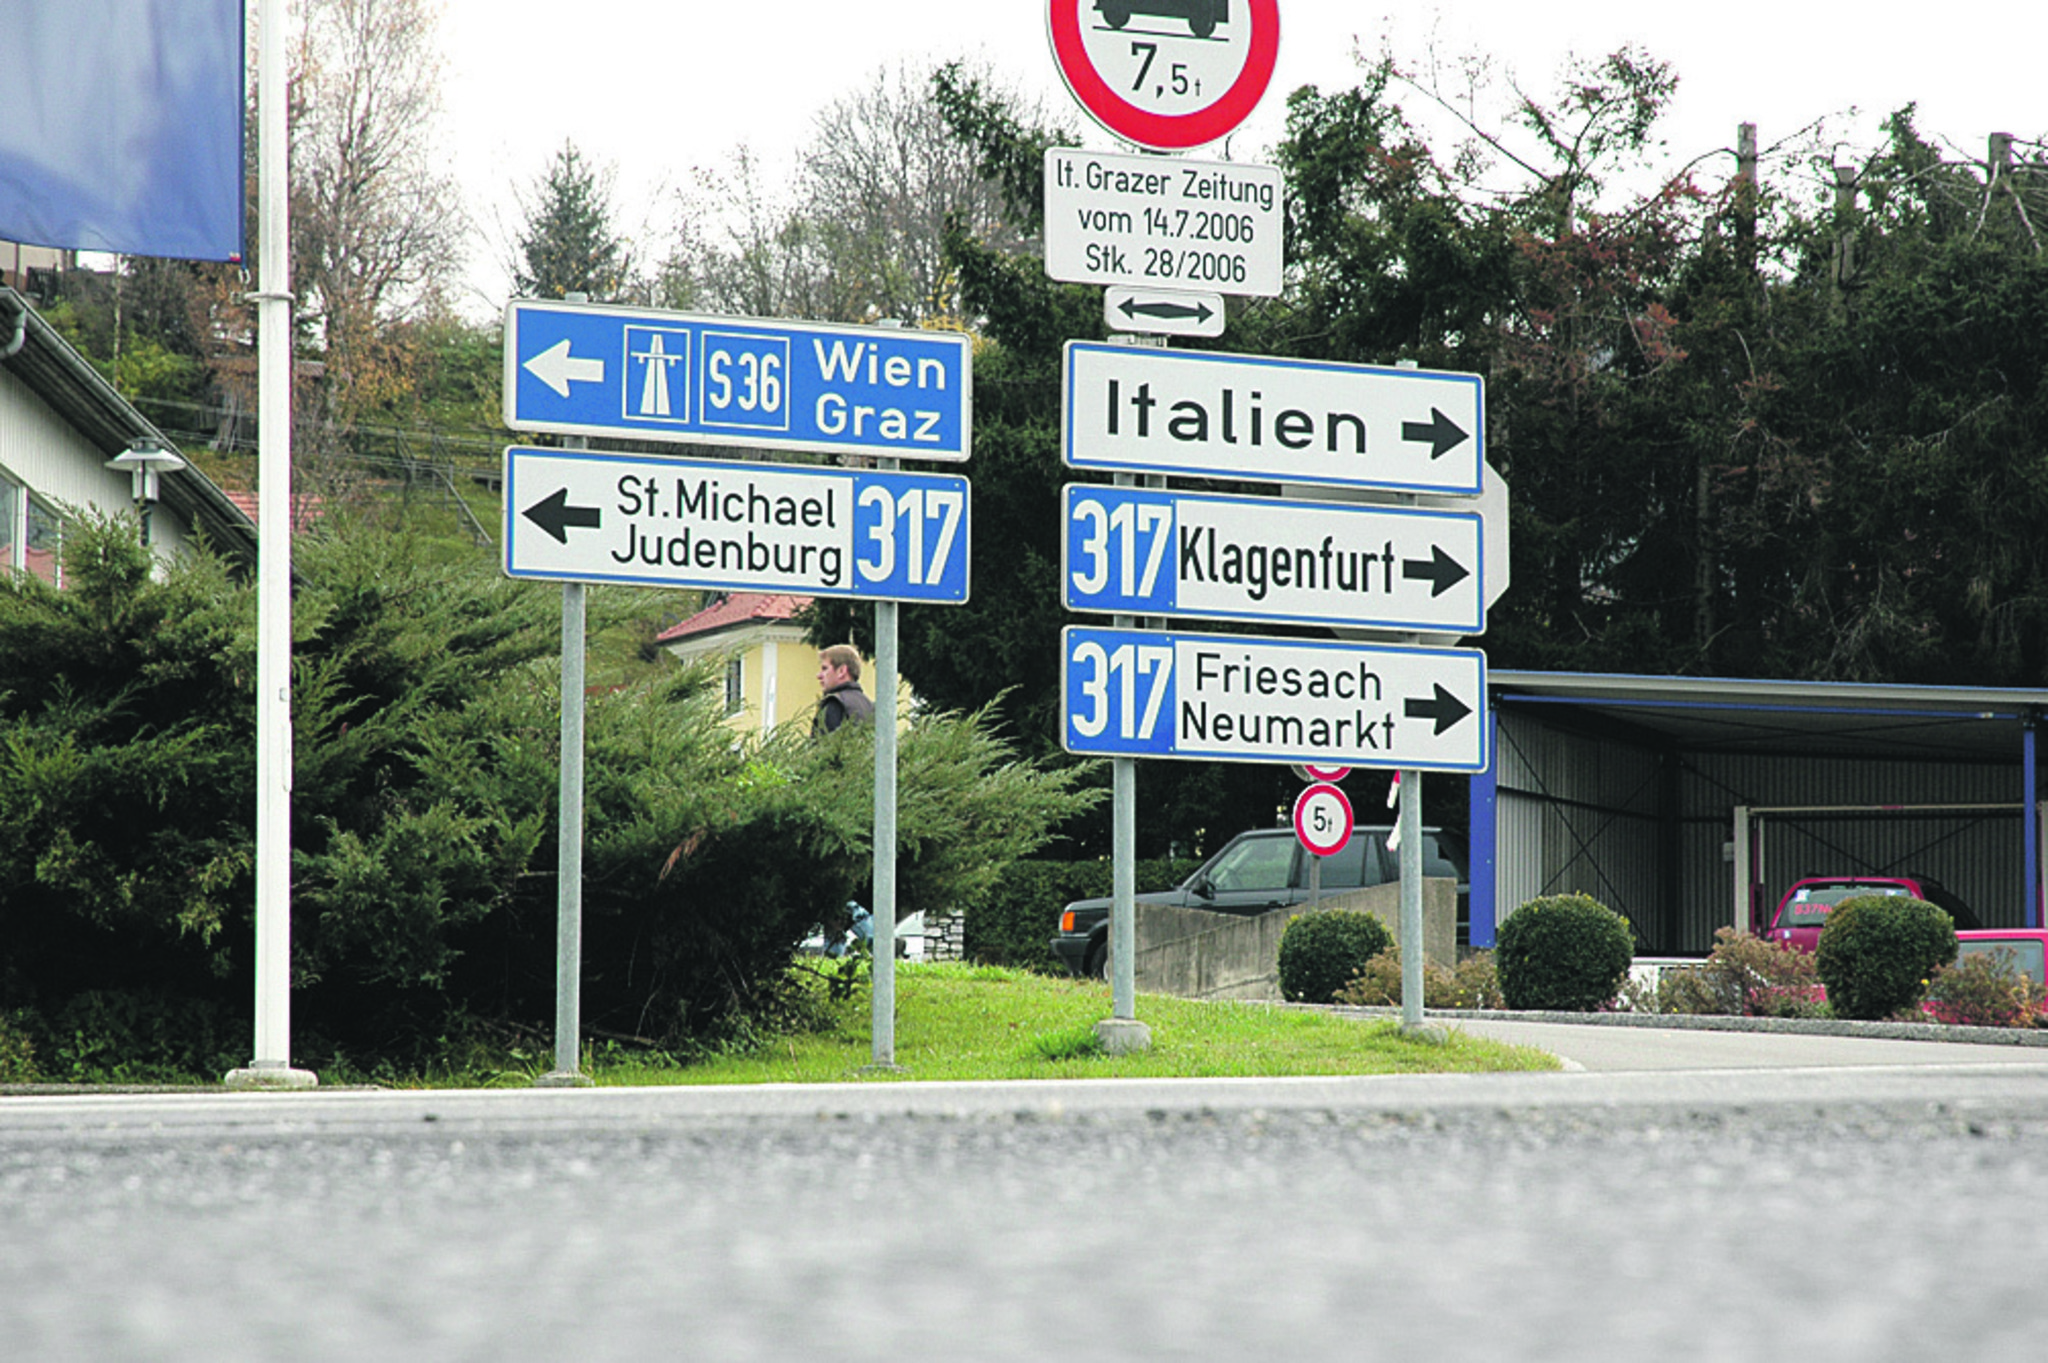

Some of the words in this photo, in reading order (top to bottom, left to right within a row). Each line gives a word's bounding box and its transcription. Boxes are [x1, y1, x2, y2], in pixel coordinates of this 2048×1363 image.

[1057, 159, 1080, 189] lt.
[1086, 161, 1171, 196] Grazer
[1182, 169, 1274, 212] Zeitung
[1078, 209, 1132, 234] vom
[1143, 208, 1254, 243] 14.7.2006
[1086, 243, 1133, 275] Stk.
[1144, 248, 1246, 283] 28/2006
[814, 339, 946, 390] Wien
[815, 393, 942, 442] Graz
[1107, 379, 1367, 454] Italien
[617, 475, 836, 528] St.Michael
[611, 524, 842, 587] Judenburg
[857, 485, 964, 586] 317
[1071, 499, 1174, 598] 317
[1180, 525, 1395, 601] Klagenfurt
[1071, 641, 1174, 740] 317
[1196, 652, 1383, 701] Friesach
[1181, 701, 1395, 750] Neumarkt
